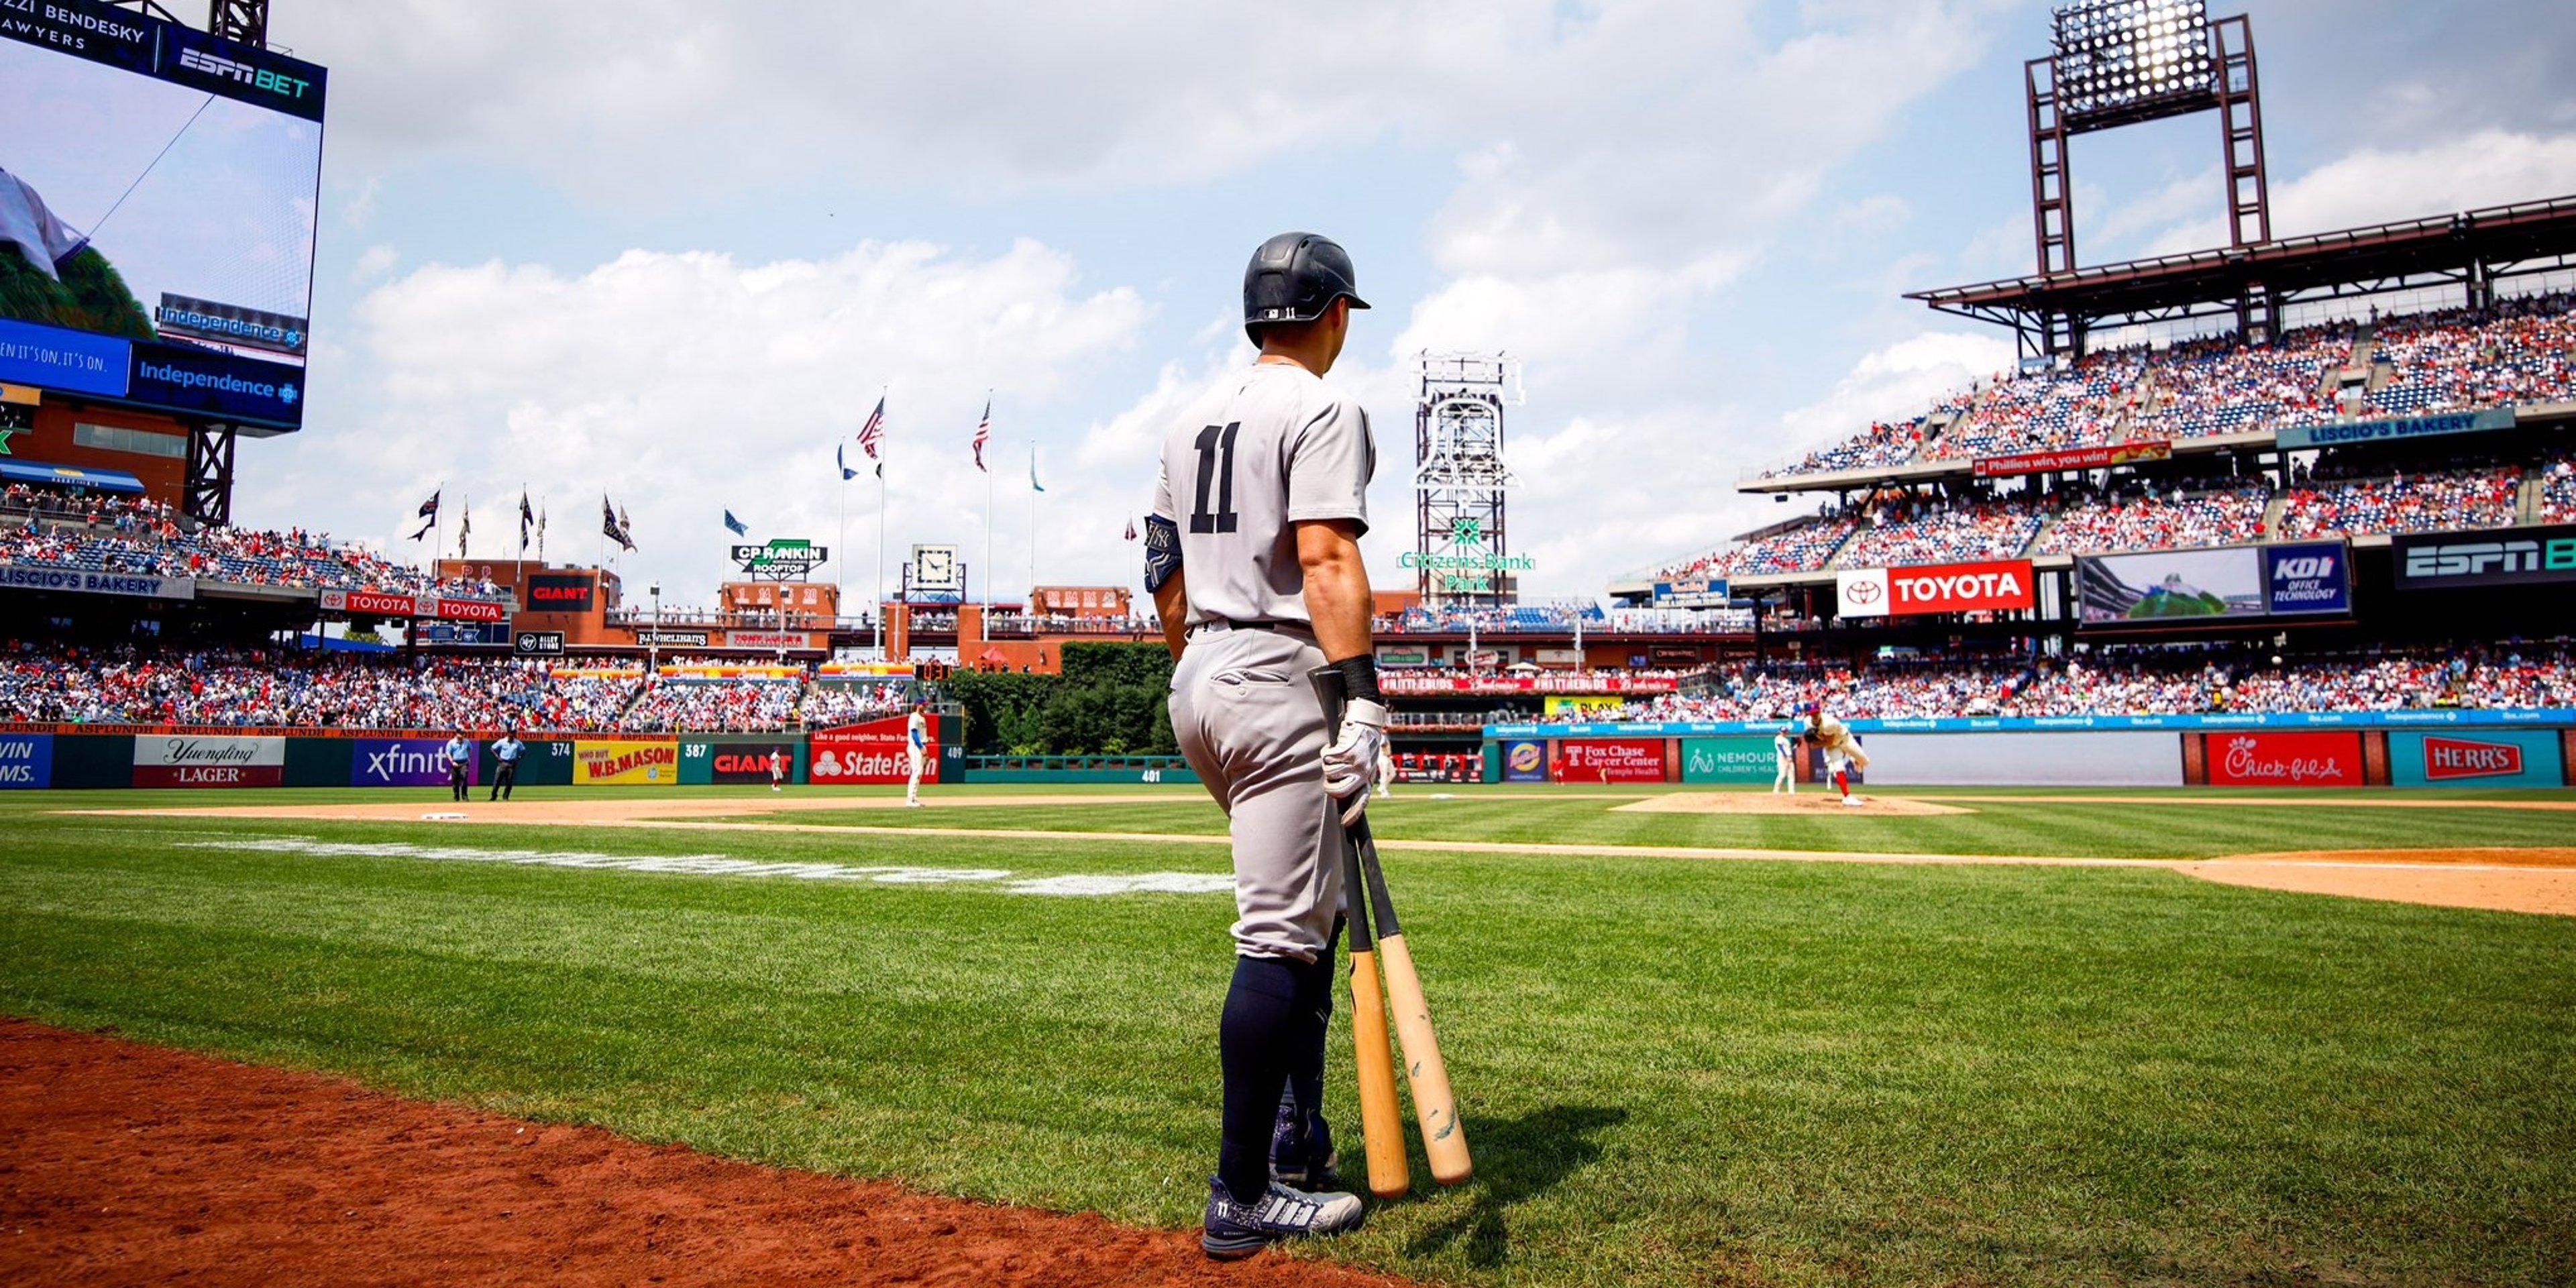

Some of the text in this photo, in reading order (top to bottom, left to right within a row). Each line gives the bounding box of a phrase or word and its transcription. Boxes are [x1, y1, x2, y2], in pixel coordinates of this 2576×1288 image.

[45, 5, 144, 43] BENDESKY
[1, 19, 85, 49] AWYERS
[180, 48, 309, 99] ESPN BET
[1285, 307, 1295, 319] 11
[161, 305, 280, 339] Independence
[18, 345, 39, 362] IT'S
[41, 349, 61, 366] ON.
[64, 352, 84, 368] IT'S
[88, 356, 108, 373] ON.
[140, 361, 274, 397] Independence
[2310, 415, 2477, 443] LISCIO'S BAKERY
[1988, 451, 2108, 472] Phillies win, you win!
[1190, 421, 1241, 534] 11
[739, 547, 820, 559] CP RANKIN
[1401, 552, 1534, 570] Citizens Bank
[2406, 540, 2539, 578] ESPN
[754, 564, 804, 572] ROOFTOP
[2275, 557, 2334, 580] KDI
[87, 574, 162, 595] BAKERY
[1446, 575, 1489, 591] Park
[1894, 573, 2021, 602] TOYOTA
[2288, 580, 2320, 591] OFFICE
[533, 587, 588, 599] GIANT
[2275, 588, 2337, 602] TECHNOLOGY
[351, 595, 411, 612] TOYOTA
[443, 603, 497, 618] TOYOTA
[2385, 713, 2445, 721] Independence
[75, 725, 154, 735] ASPLUNDH
[170, 727, 242, 735] ASPLUNDH
[257, 728, 325, 737] ASPLUNDH
[339, 729, 404, 737] ASPLUNDH
[555, 733, 608, 741] ASPLUNDH
[814, 732, 827, 740] Like
[835, 733, 850, 742] good
[164, 739, 259, 764] Yuengling
[551, 743, 570, 757] 374
[686, 745, 706, 757] 387
[947, 747, 963, 759] 409
[1585, 746, 1607, 756] Fox
[1609, 746, 1645, 756] Chase
[1717, 752, 1778, 763] NEMOUR
[2433, 747, 2509, 769] HERR'S
[367, 744, 452, 781] xfinit
[1623, 757, 1660, 766] Center
[2225, 746, 2343, 780] Chick-fil-A
[179, 768, 239, 782] LAGER
[1142, 769, 1161, 783] 401
[1218, 1201, 1228, 1218] 11
